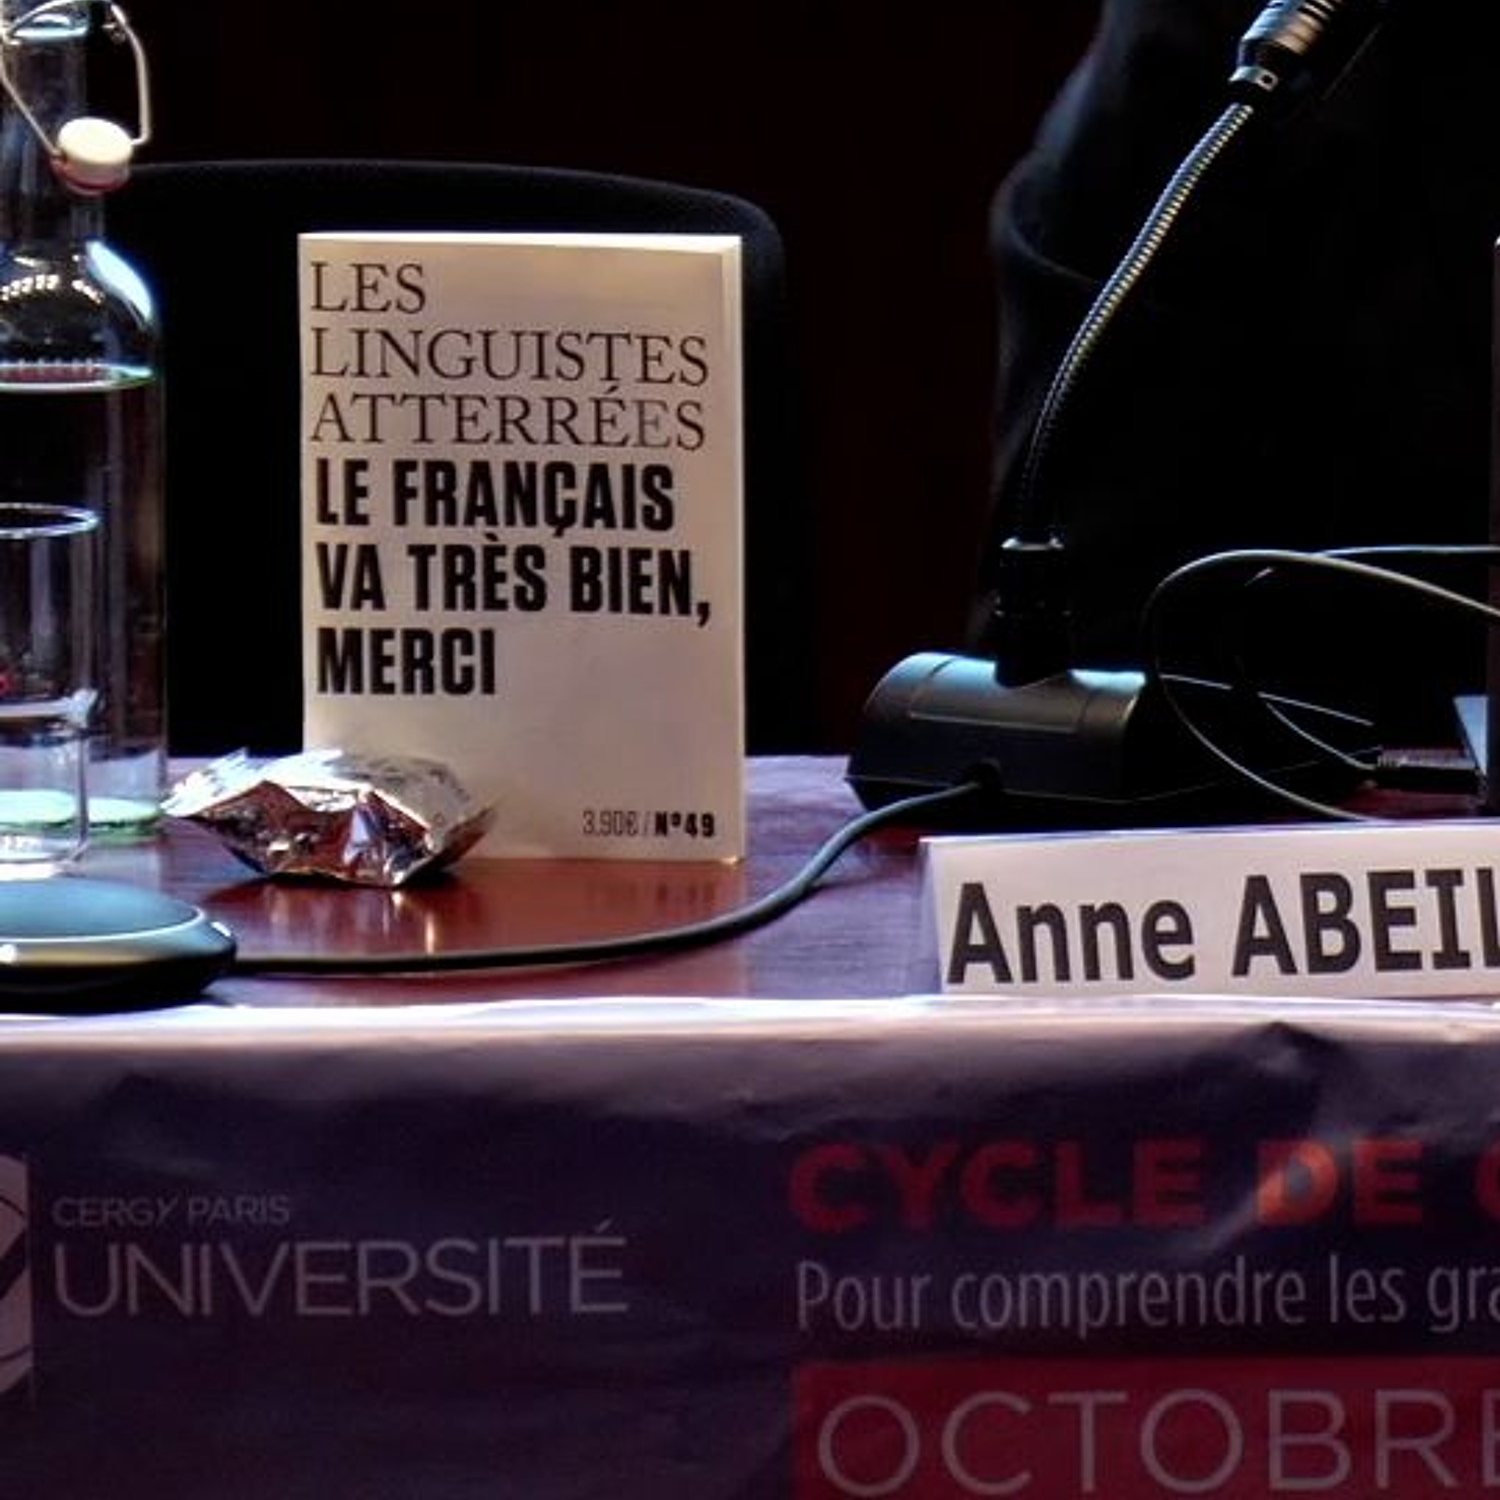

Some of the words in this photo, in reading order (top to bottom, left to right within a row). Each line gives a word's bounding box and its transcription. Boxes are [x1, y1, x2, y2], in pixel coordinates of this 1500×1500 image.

[310, 261, 427, 315] LES
[310, 327, 709, 388] LINGUISTES
[310, 385, 707, 451] ATTERRÉES
[315, 457, 371, 527] LE
[392, 459, 675, 538] FRANÇAIS
[315, 542, 386, 612] VA
[407, 532, 547, 612] TRÈS
[569, 546, 711, 627] BIEN,
[316, 627, 496, 696] MERCI
[946, 881, 1196, 985] Anne
[51, 1196, 179, 1229] CERGY
[187, 1195, 291, 1226] PARIS
[789, 1136, 1205, 1233] CYCLE
[1256, 1136, 1423, 1227] DE
[53, 1216, 629, 1318] UNIVERSITÉ
[796, 1259, 931, 1334] Pour
[950, 1255, 1307, 1339] comprendre
[1328, 1254, 1405, 1324] les
